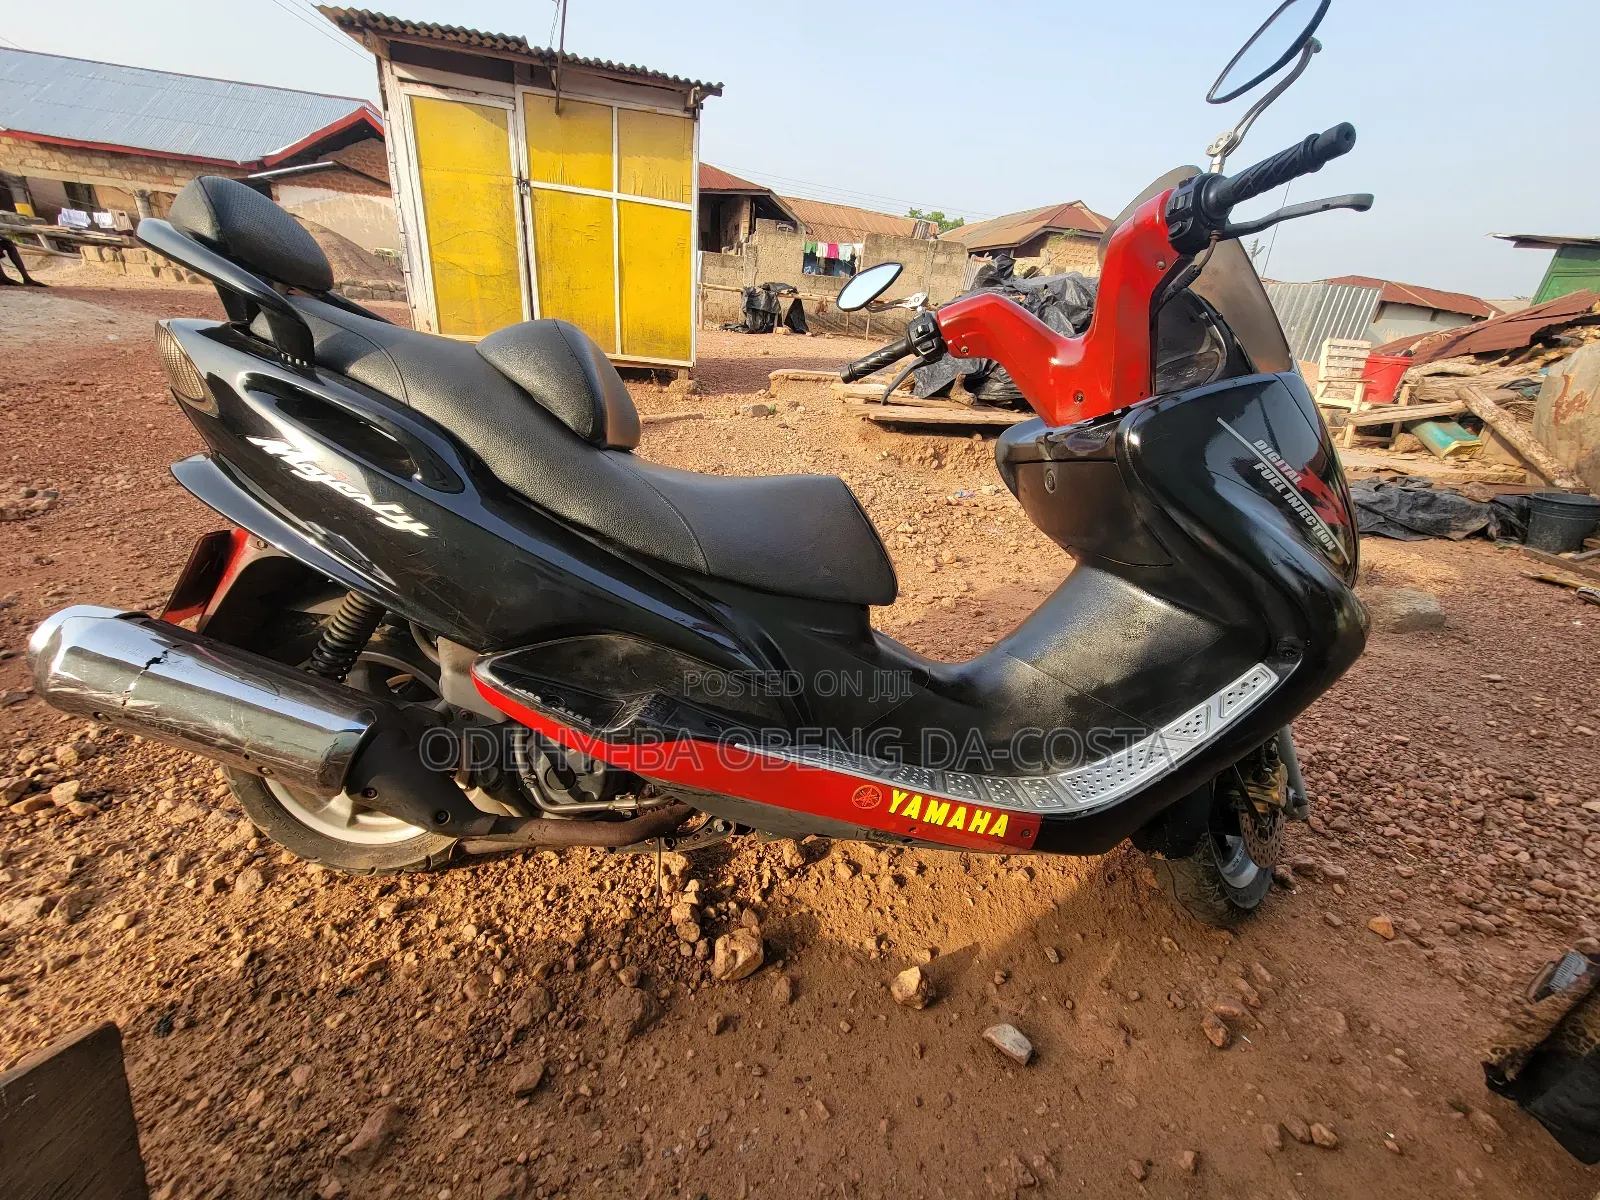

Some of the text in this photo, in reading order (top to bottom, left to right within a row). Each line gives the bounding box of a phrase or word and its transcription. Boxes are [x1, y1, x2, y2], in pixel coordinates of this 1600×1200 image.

[1253, 439, 1303, 486] DIGITAL
[1253, 462, 1336, 551] FUEL INJECTION
[888, 788, 1009, 838] YAMAHA
